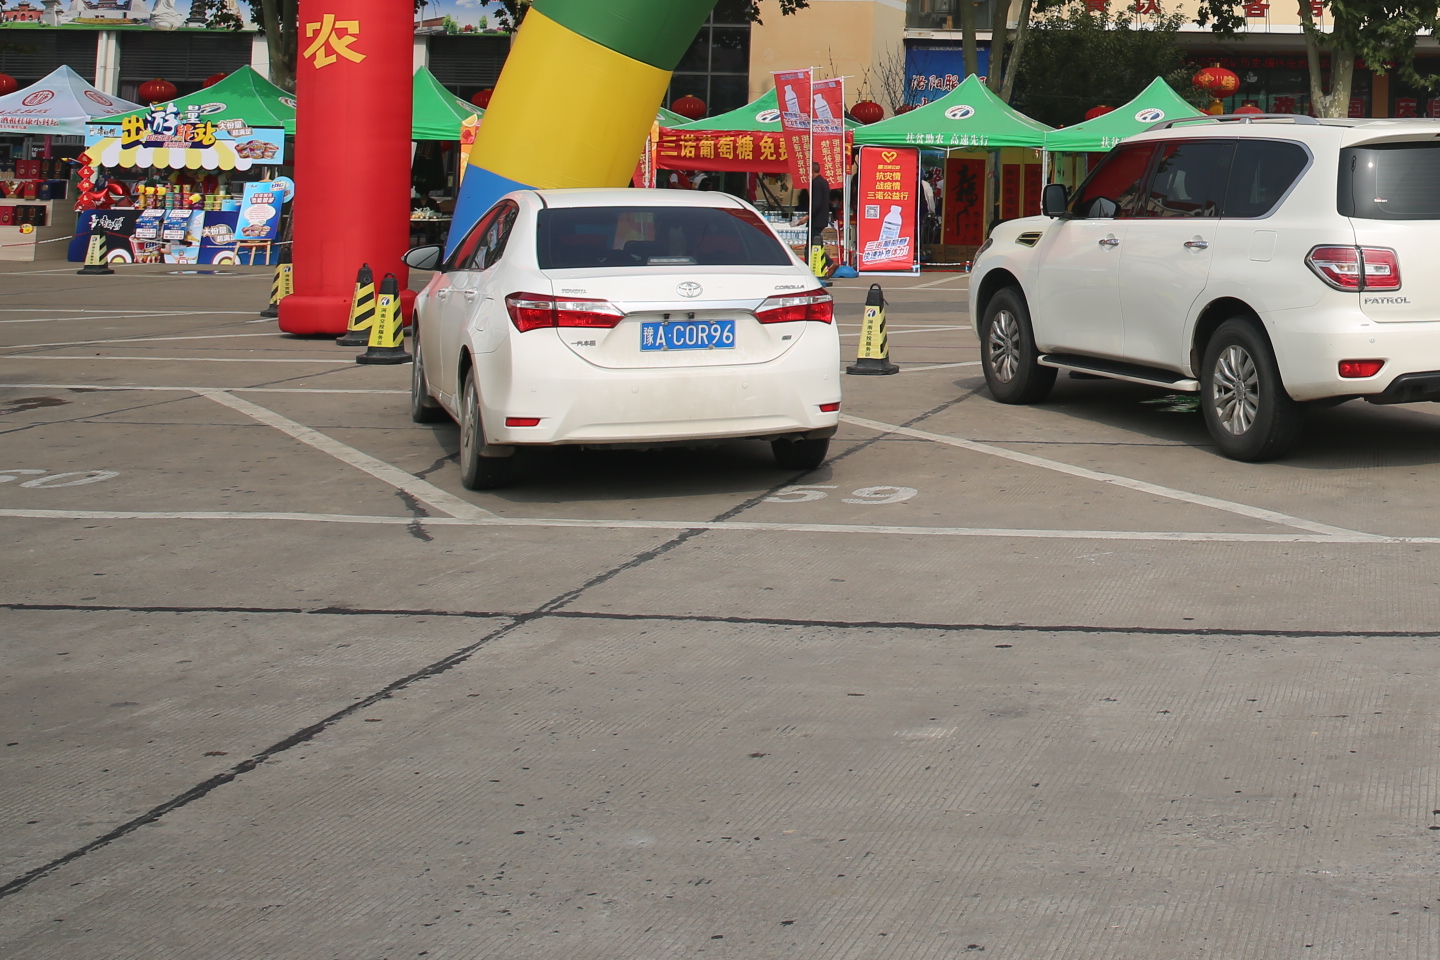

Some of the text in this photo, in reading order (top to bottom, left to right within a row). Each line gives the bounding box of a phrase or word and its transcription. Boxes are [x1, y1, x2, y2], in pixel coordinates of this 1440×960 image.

[906, 132, 989, 146] 扶贫助农 高速先行
[660, 135, 753, 160] 三诺葡萄糖
[876, 172, 901, 180] 抗灾情
[875, 182, 901, 190] 战疫情
[866, 191, 909, 200] 三诺公益行
[1364, 296, 1411, 305] PATROL
[763, 485, 918, 505] 59
